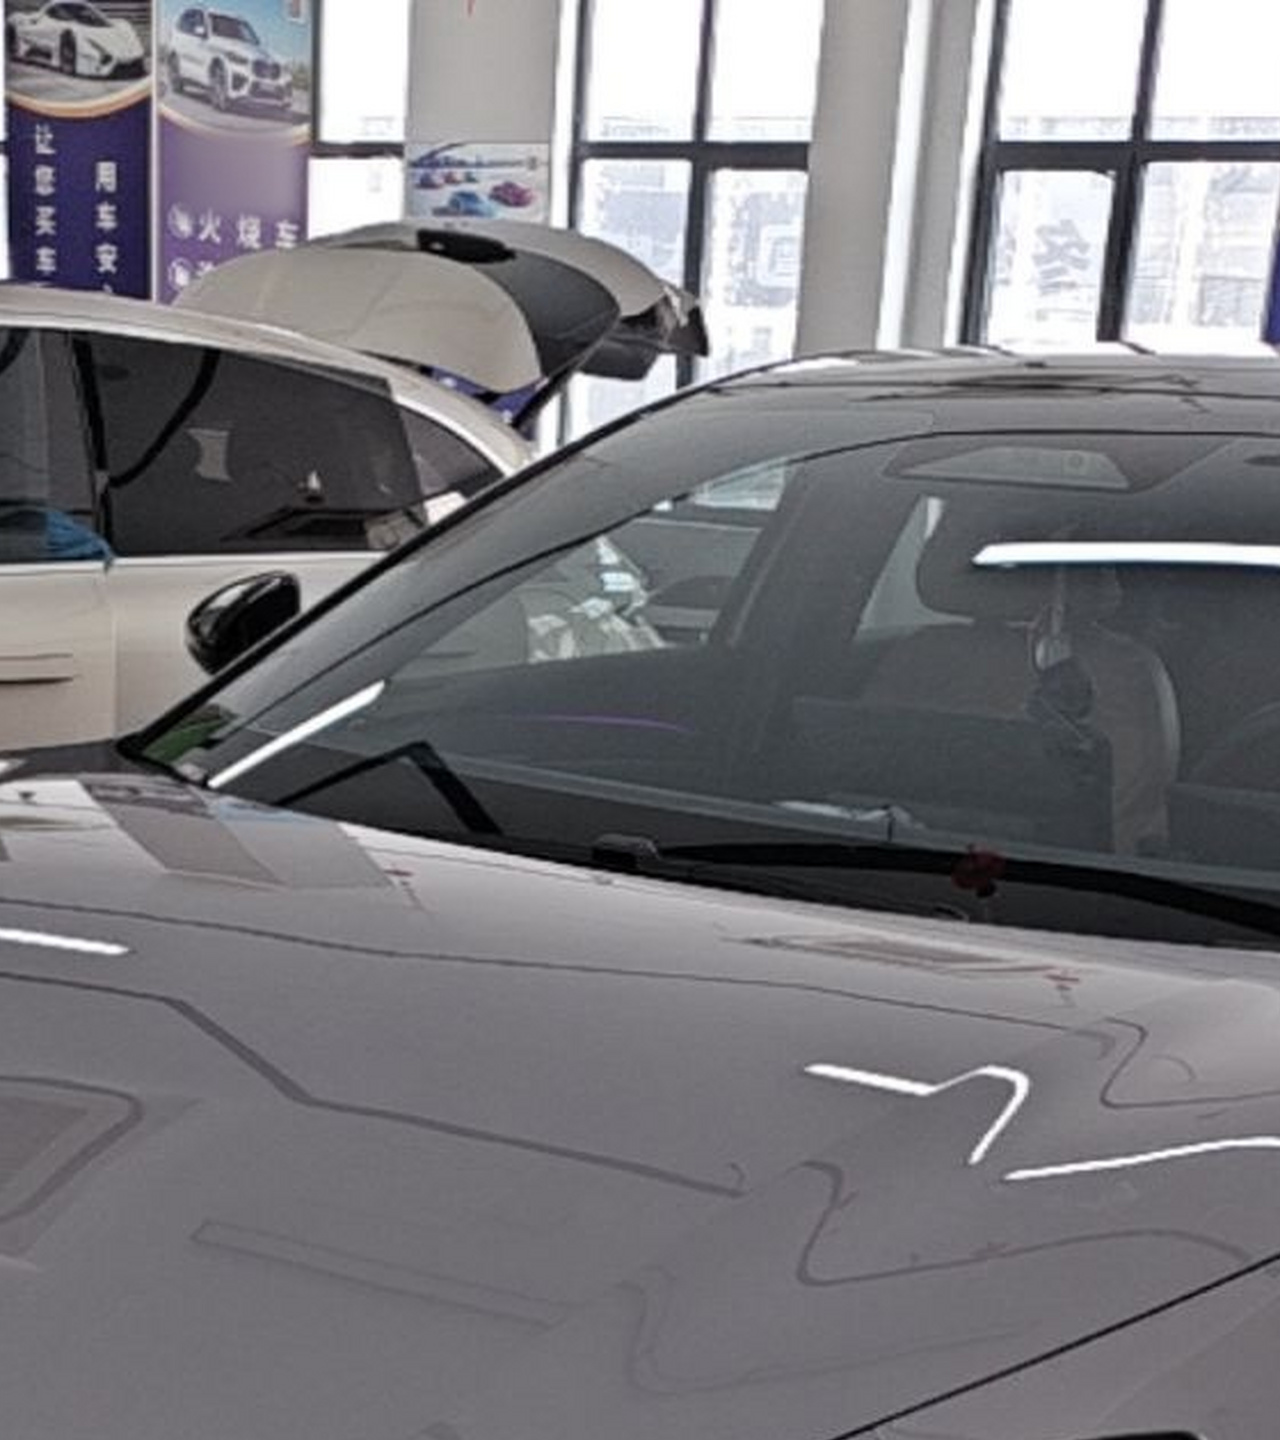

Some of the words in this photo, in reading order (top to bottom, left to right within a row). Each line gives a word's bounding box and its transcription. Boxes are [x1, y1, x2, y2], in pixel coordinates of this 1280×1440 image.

[35, 124, 57, 287] 让您买车
[95, 160, 118, 293] 用车安
